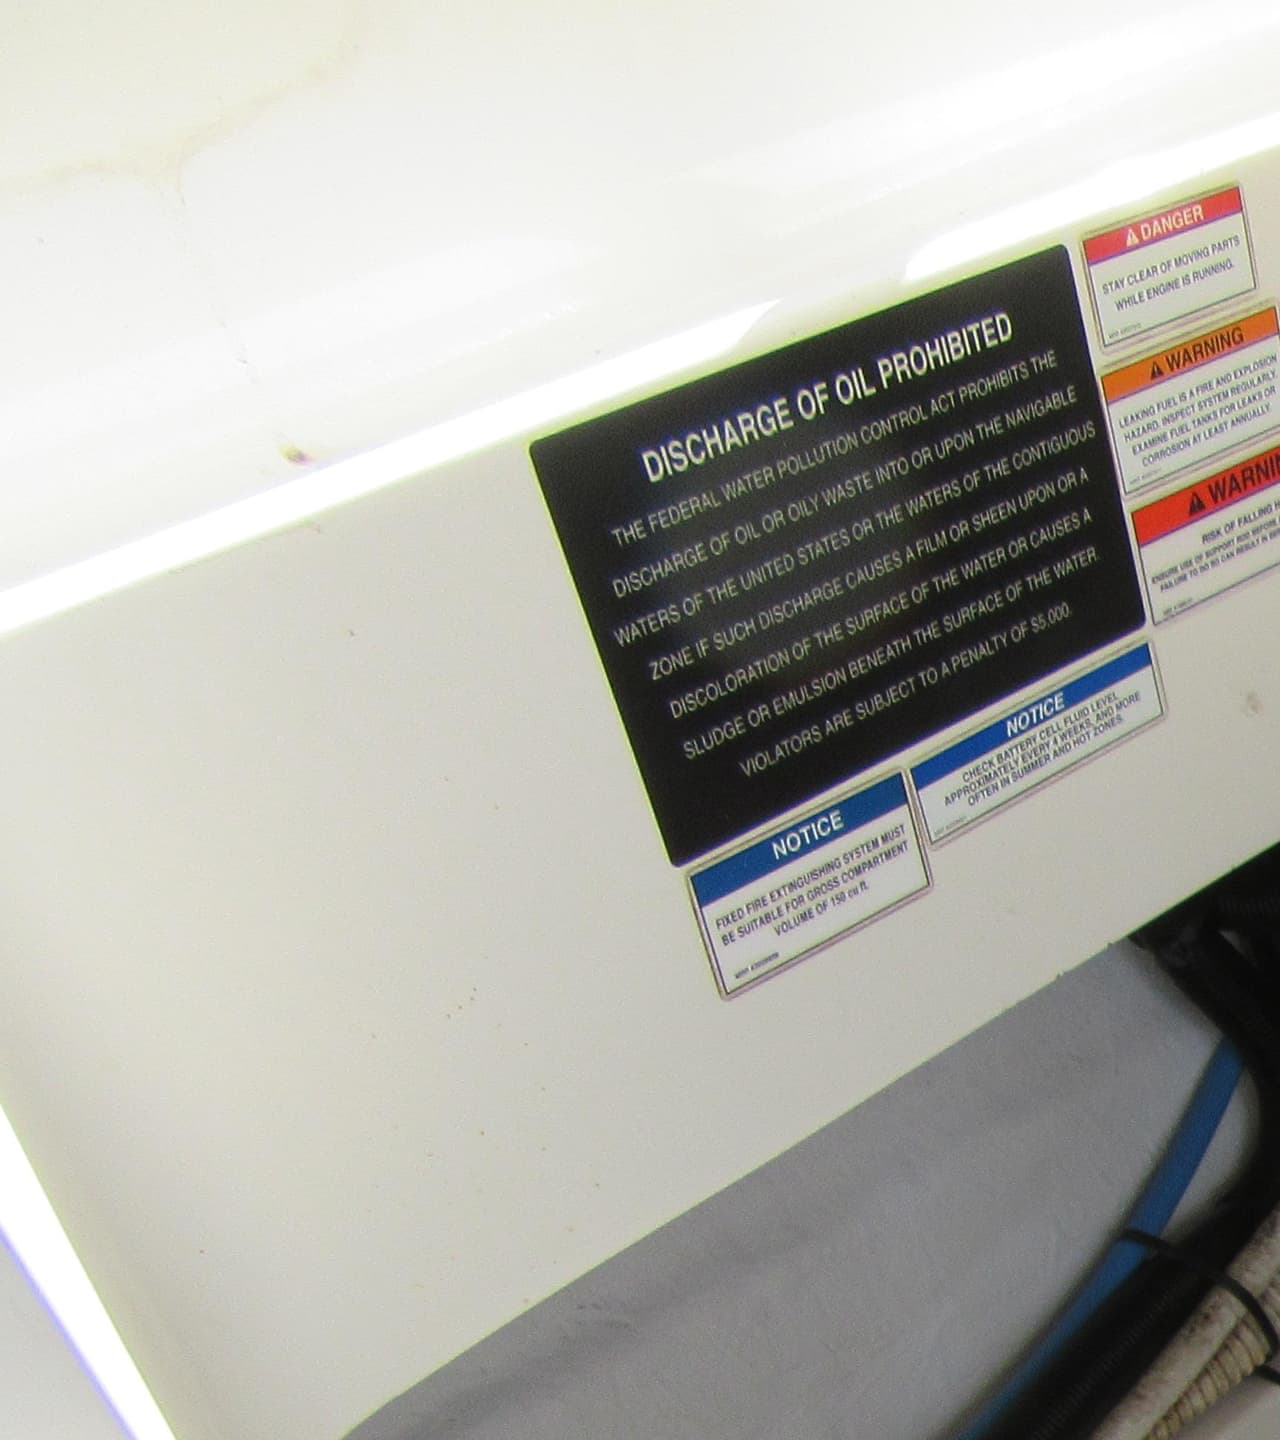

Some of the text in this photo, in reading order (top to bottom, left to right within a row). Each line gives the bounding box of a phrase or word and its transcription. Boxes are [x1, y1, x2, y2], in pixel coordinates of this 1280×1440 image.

[1101, 234, 1240, 295] STAY CLEAR OF MOVING PARTS
[1140, 203, 1204, 241] DANGER
[1114, 290, 1145, 312] WHILE
[1146, 277, 1180, 300] ENGINE
[1181, 273, 1191, 286] IS
[640, 310, 1014, 483] DISCHARGE OF OIL PROHIBITED
[1165, 324, 1244, 373] WARNING
[611, 349, 1057, 548] THE FEDERAL WATER POLLUTION CONTROL ACT PROHIBITS THE
[611, 384, 1077, 598] DISCHARGE OF OIL OR OILY WASTE INTO OR UPON THE NAVIGABLE
[613, 420, 1096, 648] WATERS OF THE UNITED STATES OR THE WATERS OF THE CONTIGUOUS
[647, 465, 1089, 681] ZONE IF SUCH DISCHARGE CAUSES A FILM OR SHEEN UPON OR A
[1201, 527, 1222, 545] RISK
[1223, 520, 1237, 534] OF
[1237, 502, 1272, 528] FALLING
[668, 506, 1092, 720] DISCOLORATION OF THE SURFACE OF THE WATER OR CAUSES A
[681, 715, 746, 760] SLUDGE
[746, 703, 772, 729] OR
[771, 666, 848, 717] EMULSION
[848, 634, 913, 680] BENEATH
[913, 620, 942, 648] THE
[942, 590, 1004, 634] SURFACE
[1004, 580, 1025, 604] OF
[1025, 567, 1052, 594] THE
[739, 723, 823, 778] VIOLATORS
[822, 707, 854, 737] ARE
[854, 676, 917, 721] SUBJECT
[918, 665, 939, 690] TO
[939, 659, 952, 679] A
[950, 630, 1009, 674] PENALTY
[1009, 620, 1030, 644] OF
[942, 756, 1021, 807] APPROXIMATELY
[1020, 739, 1051, 764] EVERY
[1052, 735, 1058, 747] 4
[1094, 704, 1114, 723] AND
[1114, 690, 1140, 713] MORE
[961, 689, 1118, 784] CHECK BATTERY CELL FLUID LEVEL
[1004, 691, 1066, 738] NOTICE
[966, 781, 999, 807] OFTEN
[999, 774, 1010, 789] IN
[1010, 752, 1051, 782] SUMMER
[1051, 740, 1072, 760] AND
[1071, 730, 1090, 748] HOT
[714, 906, 745, 931] FIXED
[744, 894, 768, 915] FIRE
[768, 855, 842, 903] EXTINGUISHING
[841, 836, 880, 865] SYSTEM
[880, 822, 906, 845] MUST
[771, 808, 845, 861] NOTICE
[720, 838, 909, 947] BE SUITABLE FOR GROSS COMPARTMENT
[773, 906, 814, 938] VOLUME
[814, 898, 829, 915] OF
